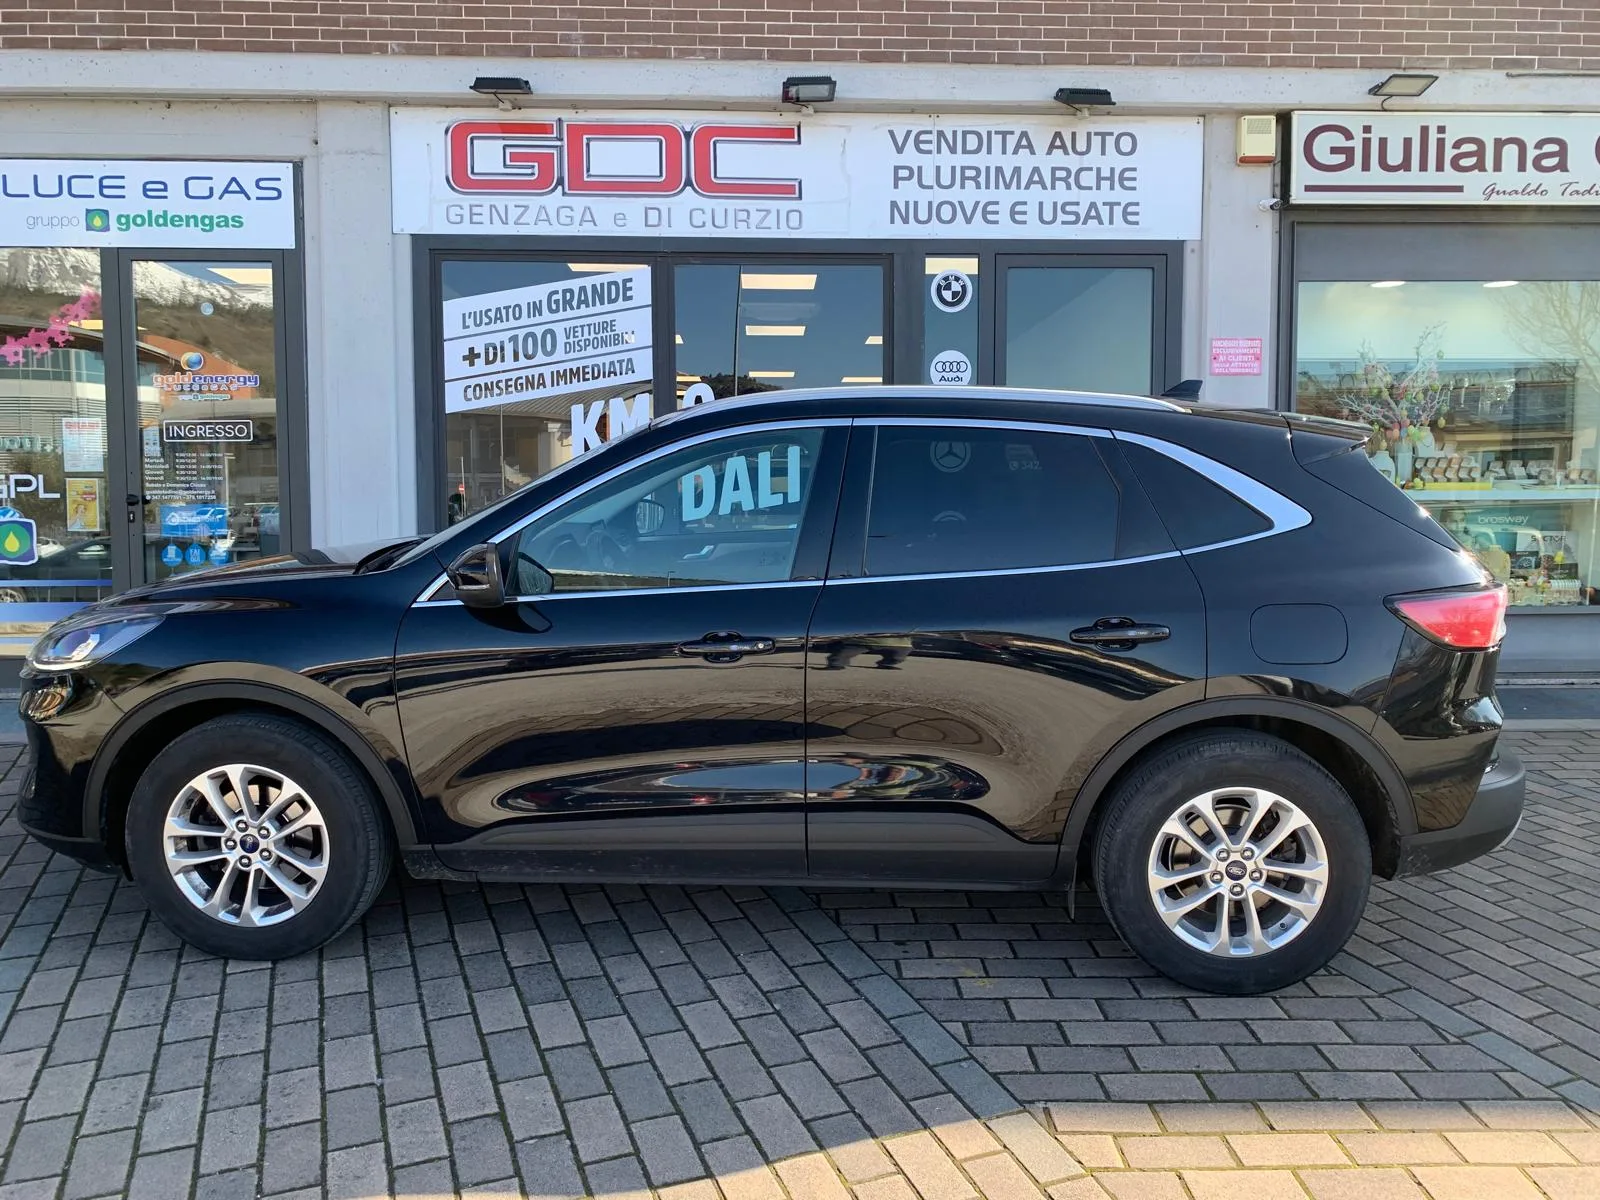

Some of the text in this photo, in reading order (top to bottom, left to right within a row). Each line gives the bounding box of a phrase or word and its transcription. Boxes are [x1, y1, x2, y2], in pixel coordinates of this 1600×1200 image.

[888, 130, 1138, 156] VENDITA AUTO
[1303, 124, 1570, 173] Giuliana
[445, 118, 802, 200] GDC
[2, 174, 283, 200] LUCE e GAS
[893, 165, 1138, 191] PLURIMARCHE
[1482, 182, 1549, 201] Gualdo
[26, 210, 244, 232] gruppo goldengas
[446, 204, 803, 230] GENZAGA e DI CURZIO
[889, 200, 1140, 226] NUOVE E USATE
[461, 278, 634, 330] L'USATO IN GRANDE
[564, 319, 617, 340] VETTURE
[153, 372, 259, 387] goldenergy
[463, 357, 635, 402] CONSEGNA IMMEDIATA
[939, 375, 963, 383] Audi
[168, 424, 248, 437] INGRESSO
[571, 392, 650, 460] KM
[0, 474, 60, 498] PL
[682, 445, 800, 521] DALI
